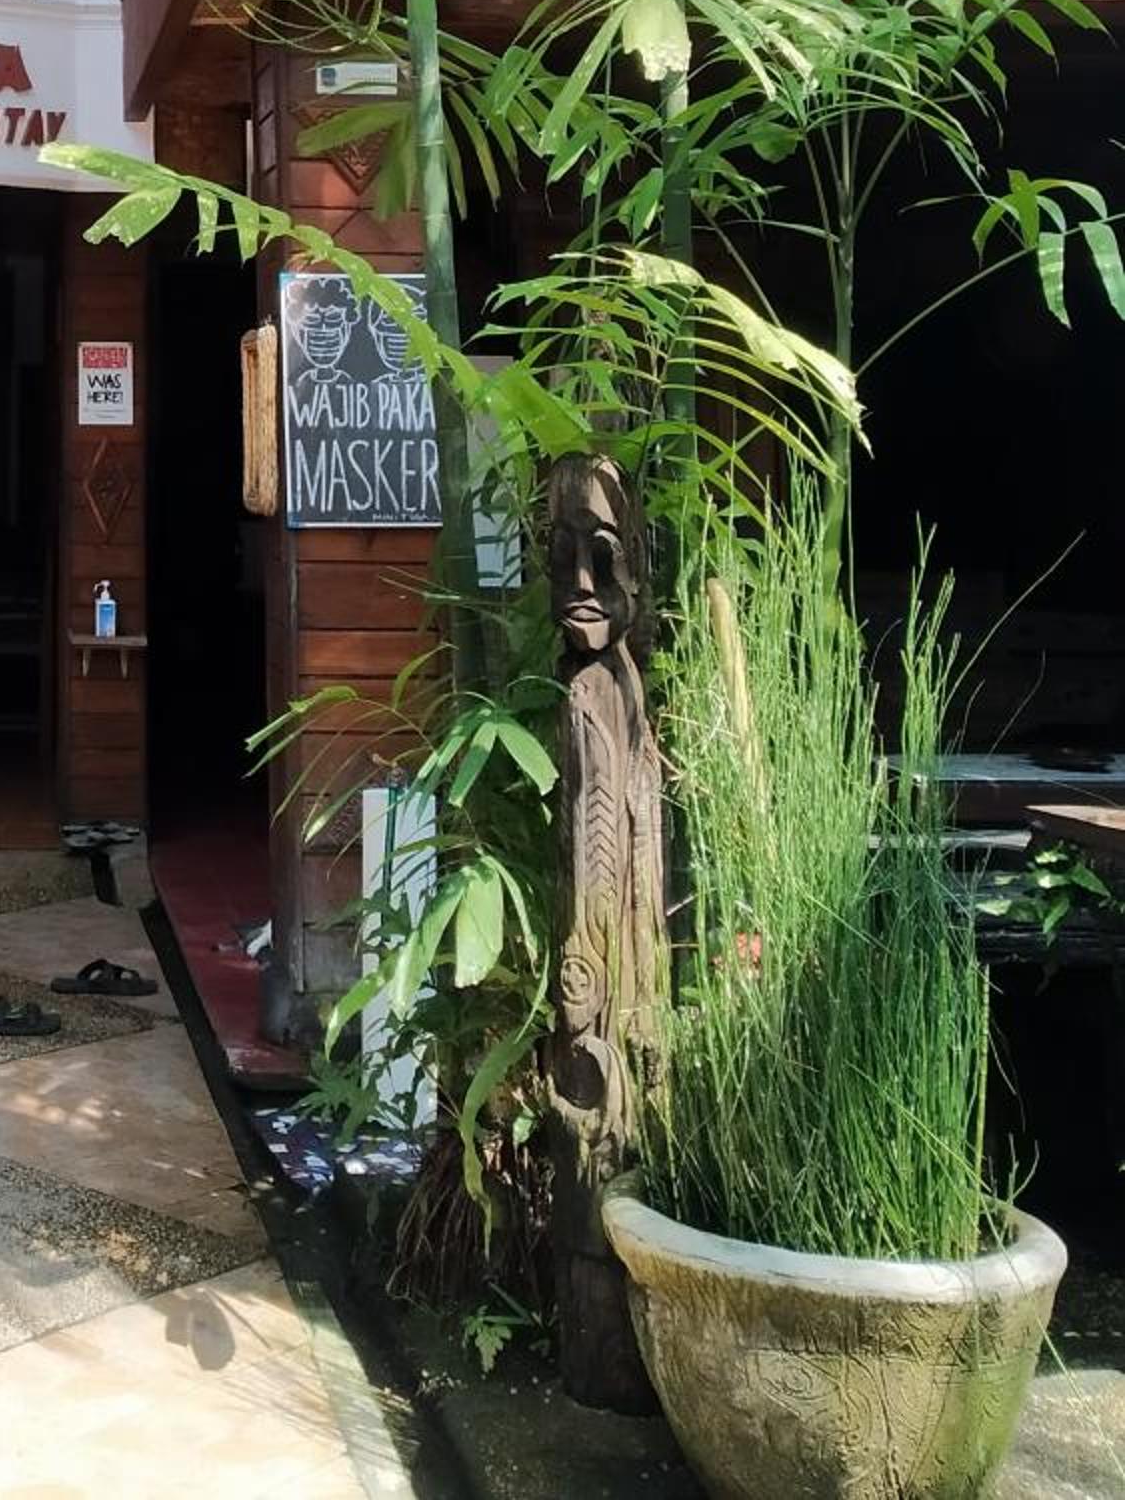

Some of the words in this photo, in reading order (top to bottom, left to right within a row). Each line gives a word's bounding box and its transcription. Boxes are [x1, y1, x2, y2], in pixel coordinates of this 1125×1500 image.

[86, 373, 122, 389] WAS
[287, 382, 371, 428] WAJIB
[294, 438, 442, 513] MASKER
